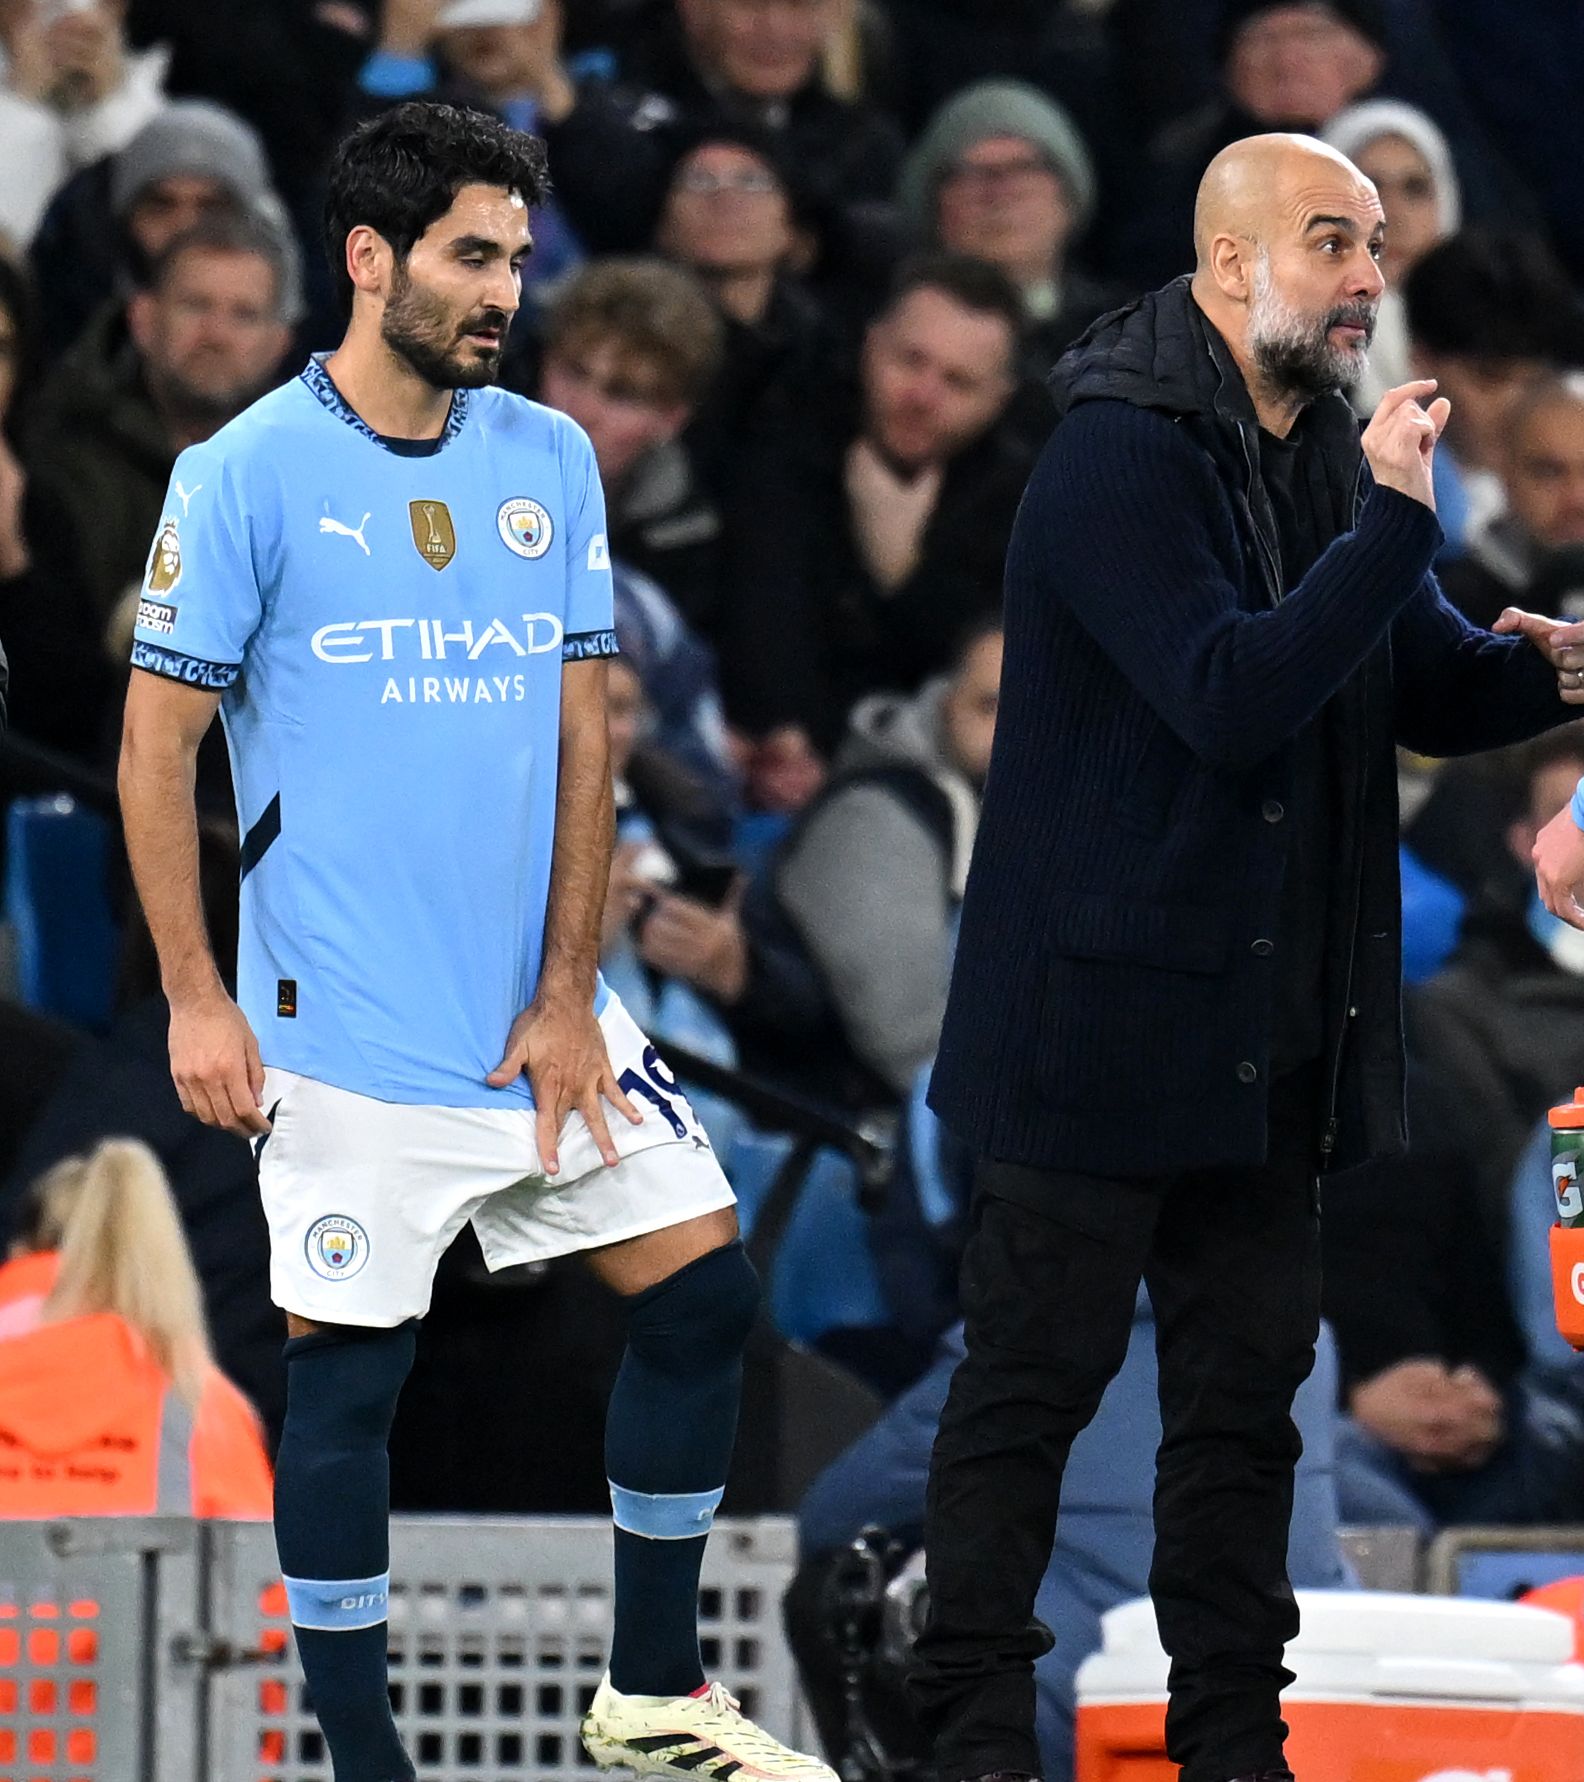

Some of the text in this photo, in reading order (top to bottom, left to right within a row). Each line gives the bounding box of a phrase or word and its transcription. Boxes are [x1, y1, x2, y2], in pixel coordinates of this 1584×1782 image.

[426, 543, 447, 553] FIFA
[310, 612, 563, 664] ETIHAD
[380, 674, 525, 704] AIRWAYS
[1552, 1161, 1583, 1218] G
[313, 1219, 362, 1241] MANCHESTER
